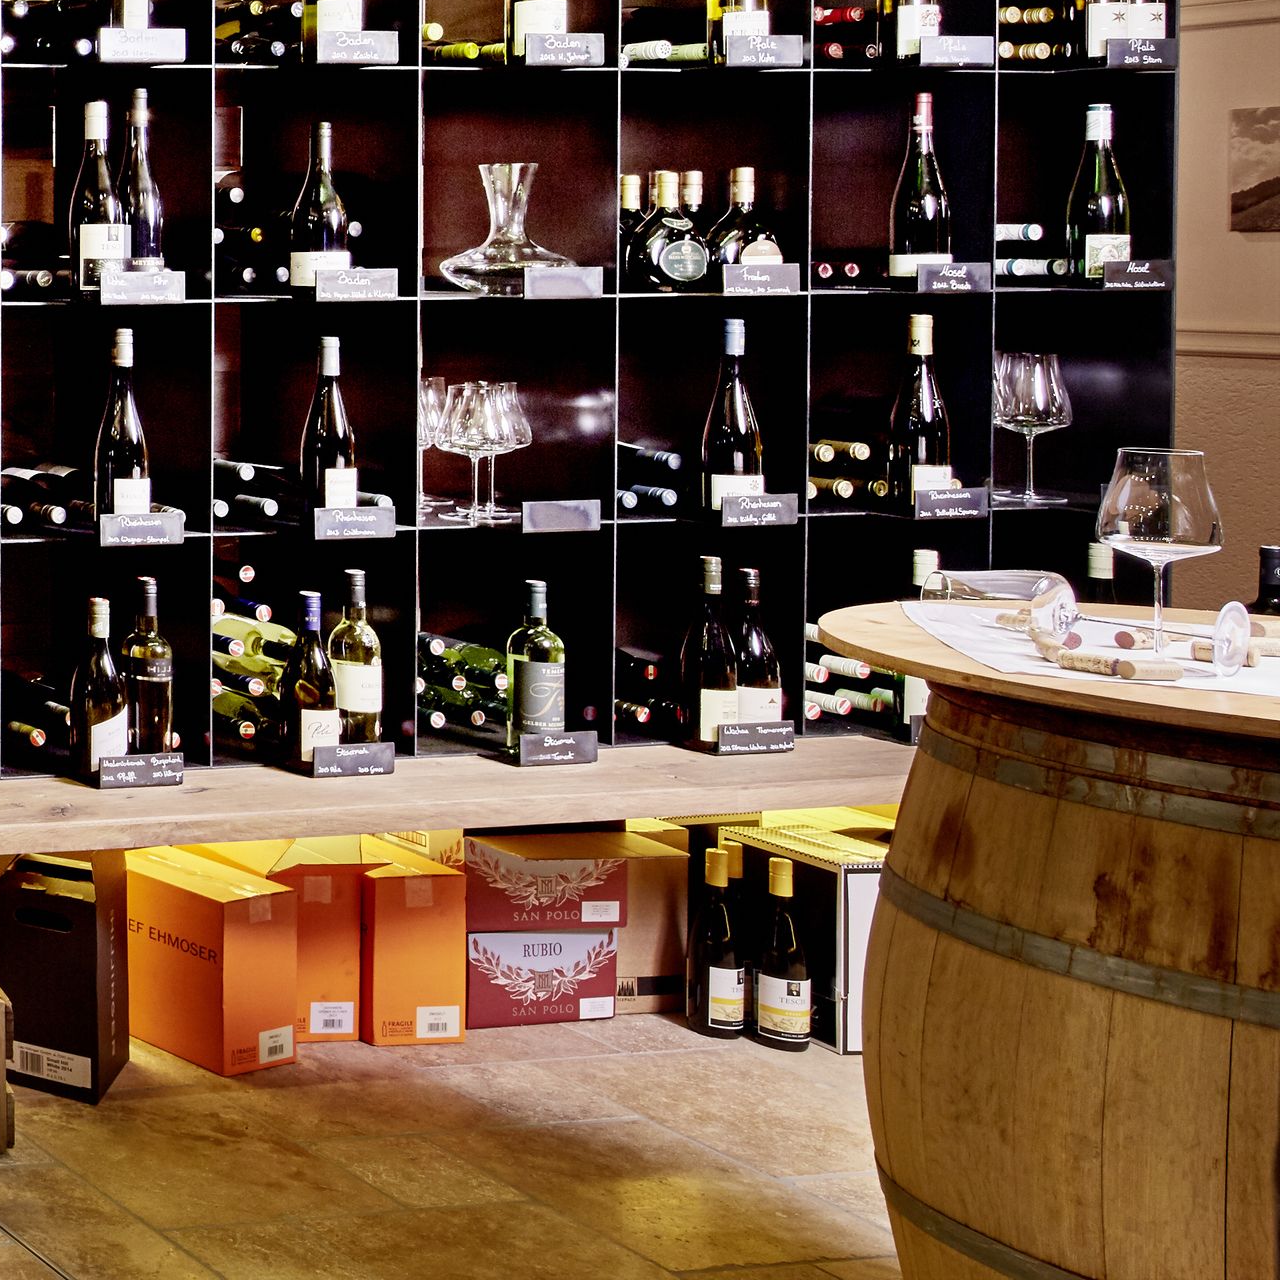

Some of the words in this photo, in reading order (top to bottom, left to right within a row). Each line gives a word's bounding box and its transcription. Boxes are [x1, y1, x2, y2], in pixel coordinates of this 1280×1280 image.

[337, 32, 375, 46] Baden
[544, 35, 581, 49] Baden
[1128, 38, 1156, 52] Pfalz
[1127, 263, 1150, 273] Mosel
[338, 272, 370, 285] Baden
[514, 911, 540, 921] SAN
[546, 910, 580, 920] POLO
[149, 926, 217, 965] EHMOSER
[523, 942, 562, 957] RUBIO
[512, 1006, 537, 1016] SAN
[543, 1004, 574, 1015] POLO
